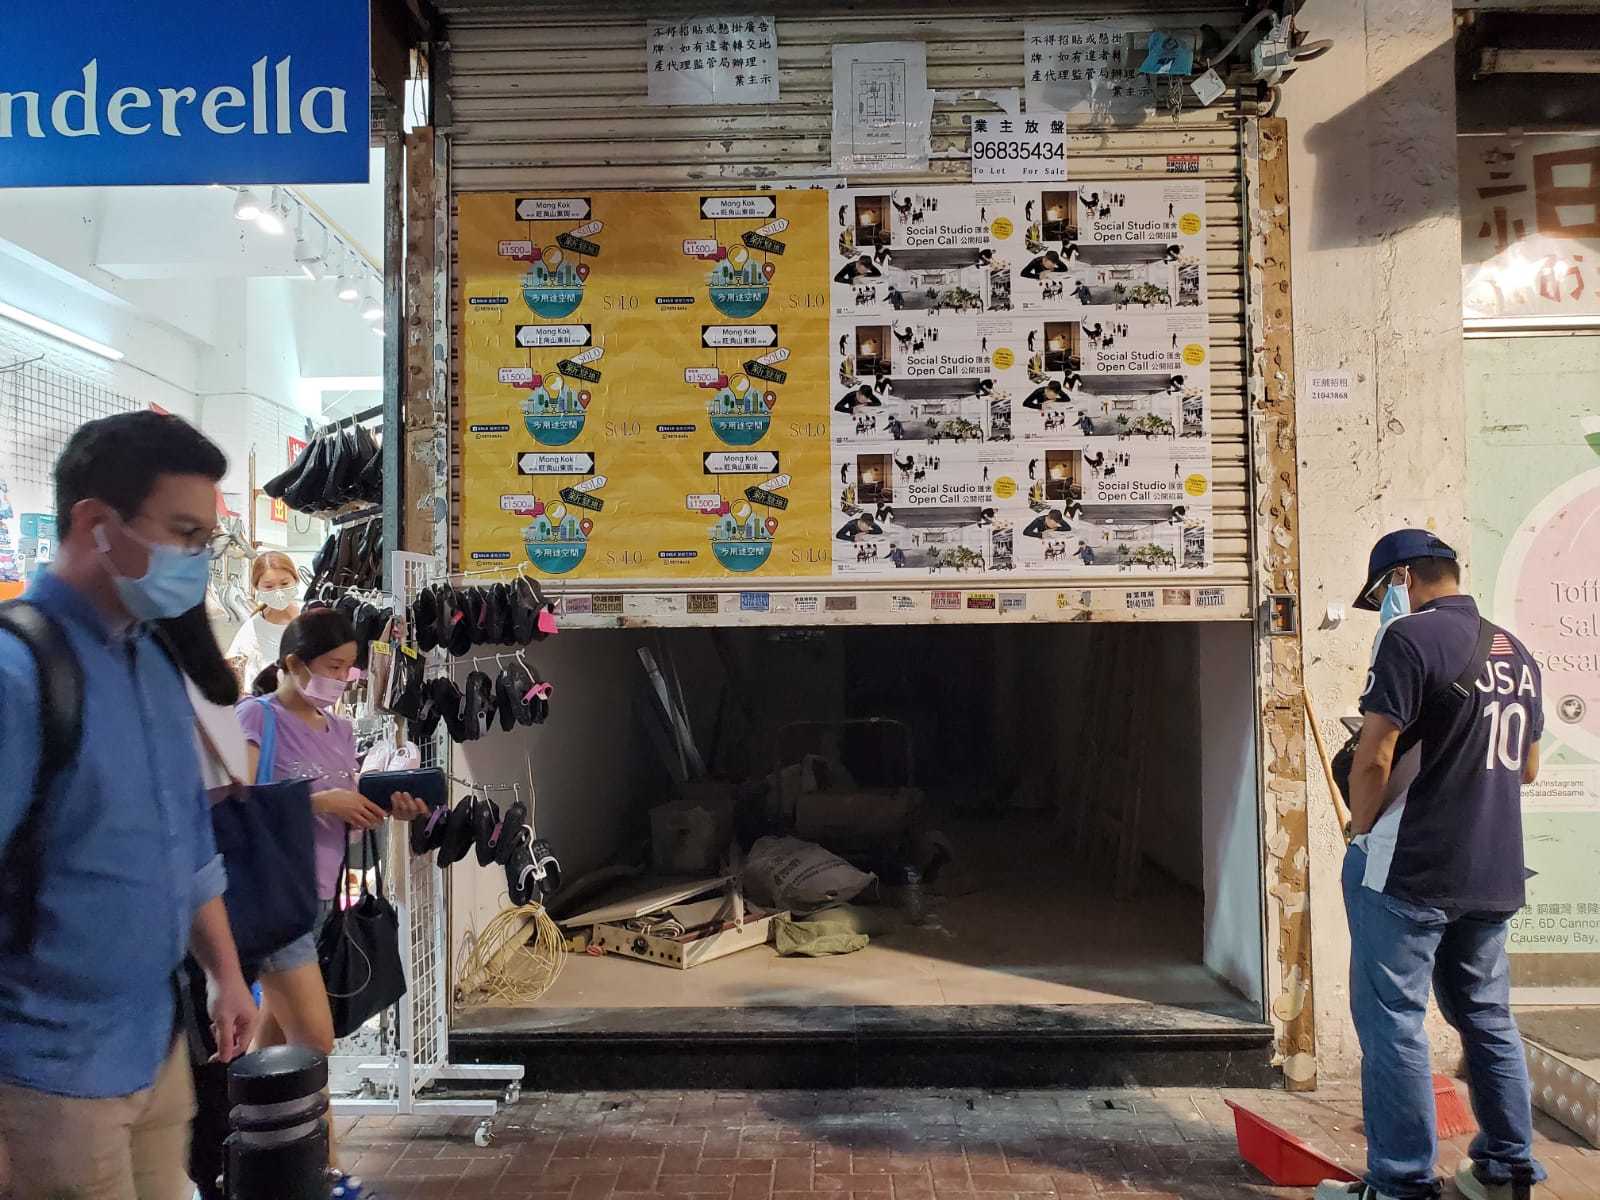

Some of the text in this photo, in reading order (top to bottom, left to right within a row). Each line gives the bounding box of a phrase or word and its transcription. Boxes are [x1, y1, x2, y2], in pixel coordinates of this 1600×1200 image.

[974, 118, 1064, 134] 業主放盤
[973, 141, 1065, 160] 96835434
[973, 167, 1065, 175] To Let For Sale
[536, 201, 571, 210] Mong Kok
[720, 199, 755, 208] Mong Kok
[906, 225, 937, 236] Social
[940, 224, 973, 235] Studio
[1094, 221, 1125, 231] Social
[1127, 220, 1161, 230] Studio
[906, 236, 935, 247] Open
[938, 235, 957, 245] Call
[1094, 232, 1122, 243] Open
[1125, 231, 1146, 241] Call
[536, 327, 571, 336] Mong Kok
[722, 328, 743, 336] Mong
[907, 355, 938, 365] Social
[940, 355, 974, 364] Studio
[1097, 351, 1128, 361] Social
[1131, 351, 1164, 360] Studio
[907, 366, 935, 376] Open
[938, 366, 958, 375] Call
[1097, 362, 1125, 373] Open
[1128, 361, 1149, 371] Call
[539, 455, 574, 464] Mong Kok
[724, 454, 758, 463] Mong Kok
[908, 484, 939, 494] Social
[942, 484, 976, 493] Studio
[1098, 481, 1130, 490] Social
[1132, 480, 1167, 490] Studio
[908, 494, 936, 505] Open
[939, 494, 960, 503] Call
[1098, 491, 1127, 502] Open
[1129, 491, 1150, 500] Call
[1482, 701, 1526, 771] 10
[1538, 918, 1555, 929] 6D
[1510, 932, 1569, 944] Causeway
